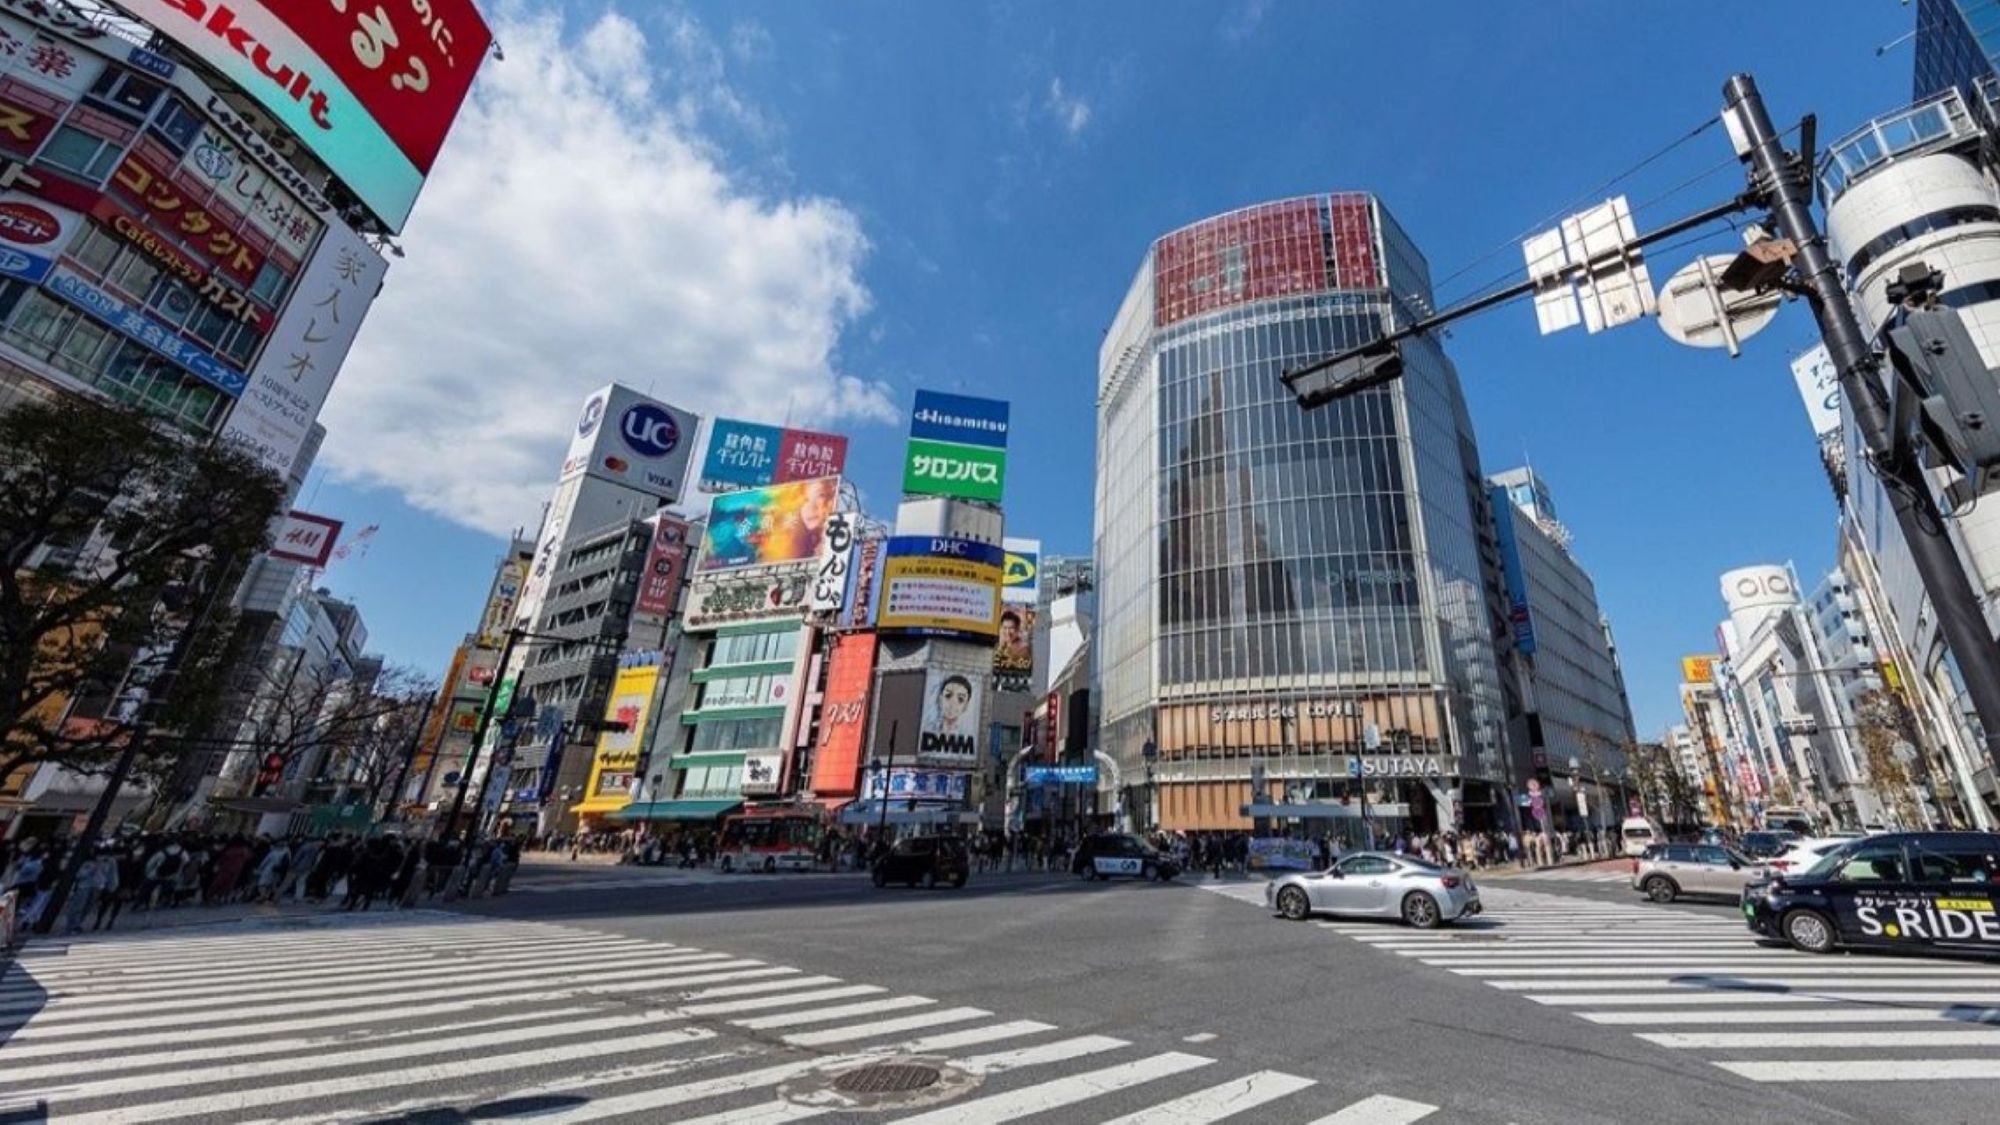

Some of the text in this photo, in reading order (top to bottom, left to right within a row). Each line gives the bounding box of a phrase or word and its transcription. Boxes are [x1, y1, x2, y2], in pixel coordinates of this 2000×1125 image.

[331, 0, 429, 92] る?
[114, 156, 254, 270] コンタクト
[199, 273, 262, 324] ガスト
[121, 313, 245, 389] 英会話イーオン
[625, 410, 678, 450] UC
[915, 408, 1007, 432] Hisamitsu
[647, 471, 674, 489] VISA
[814, 512, 853, 607] もんじゃ
[930, 538, 969, 555] DHC
[922, 731, 975, 755] DMM
[1857, 907, 2000, 941] S.RIDE
